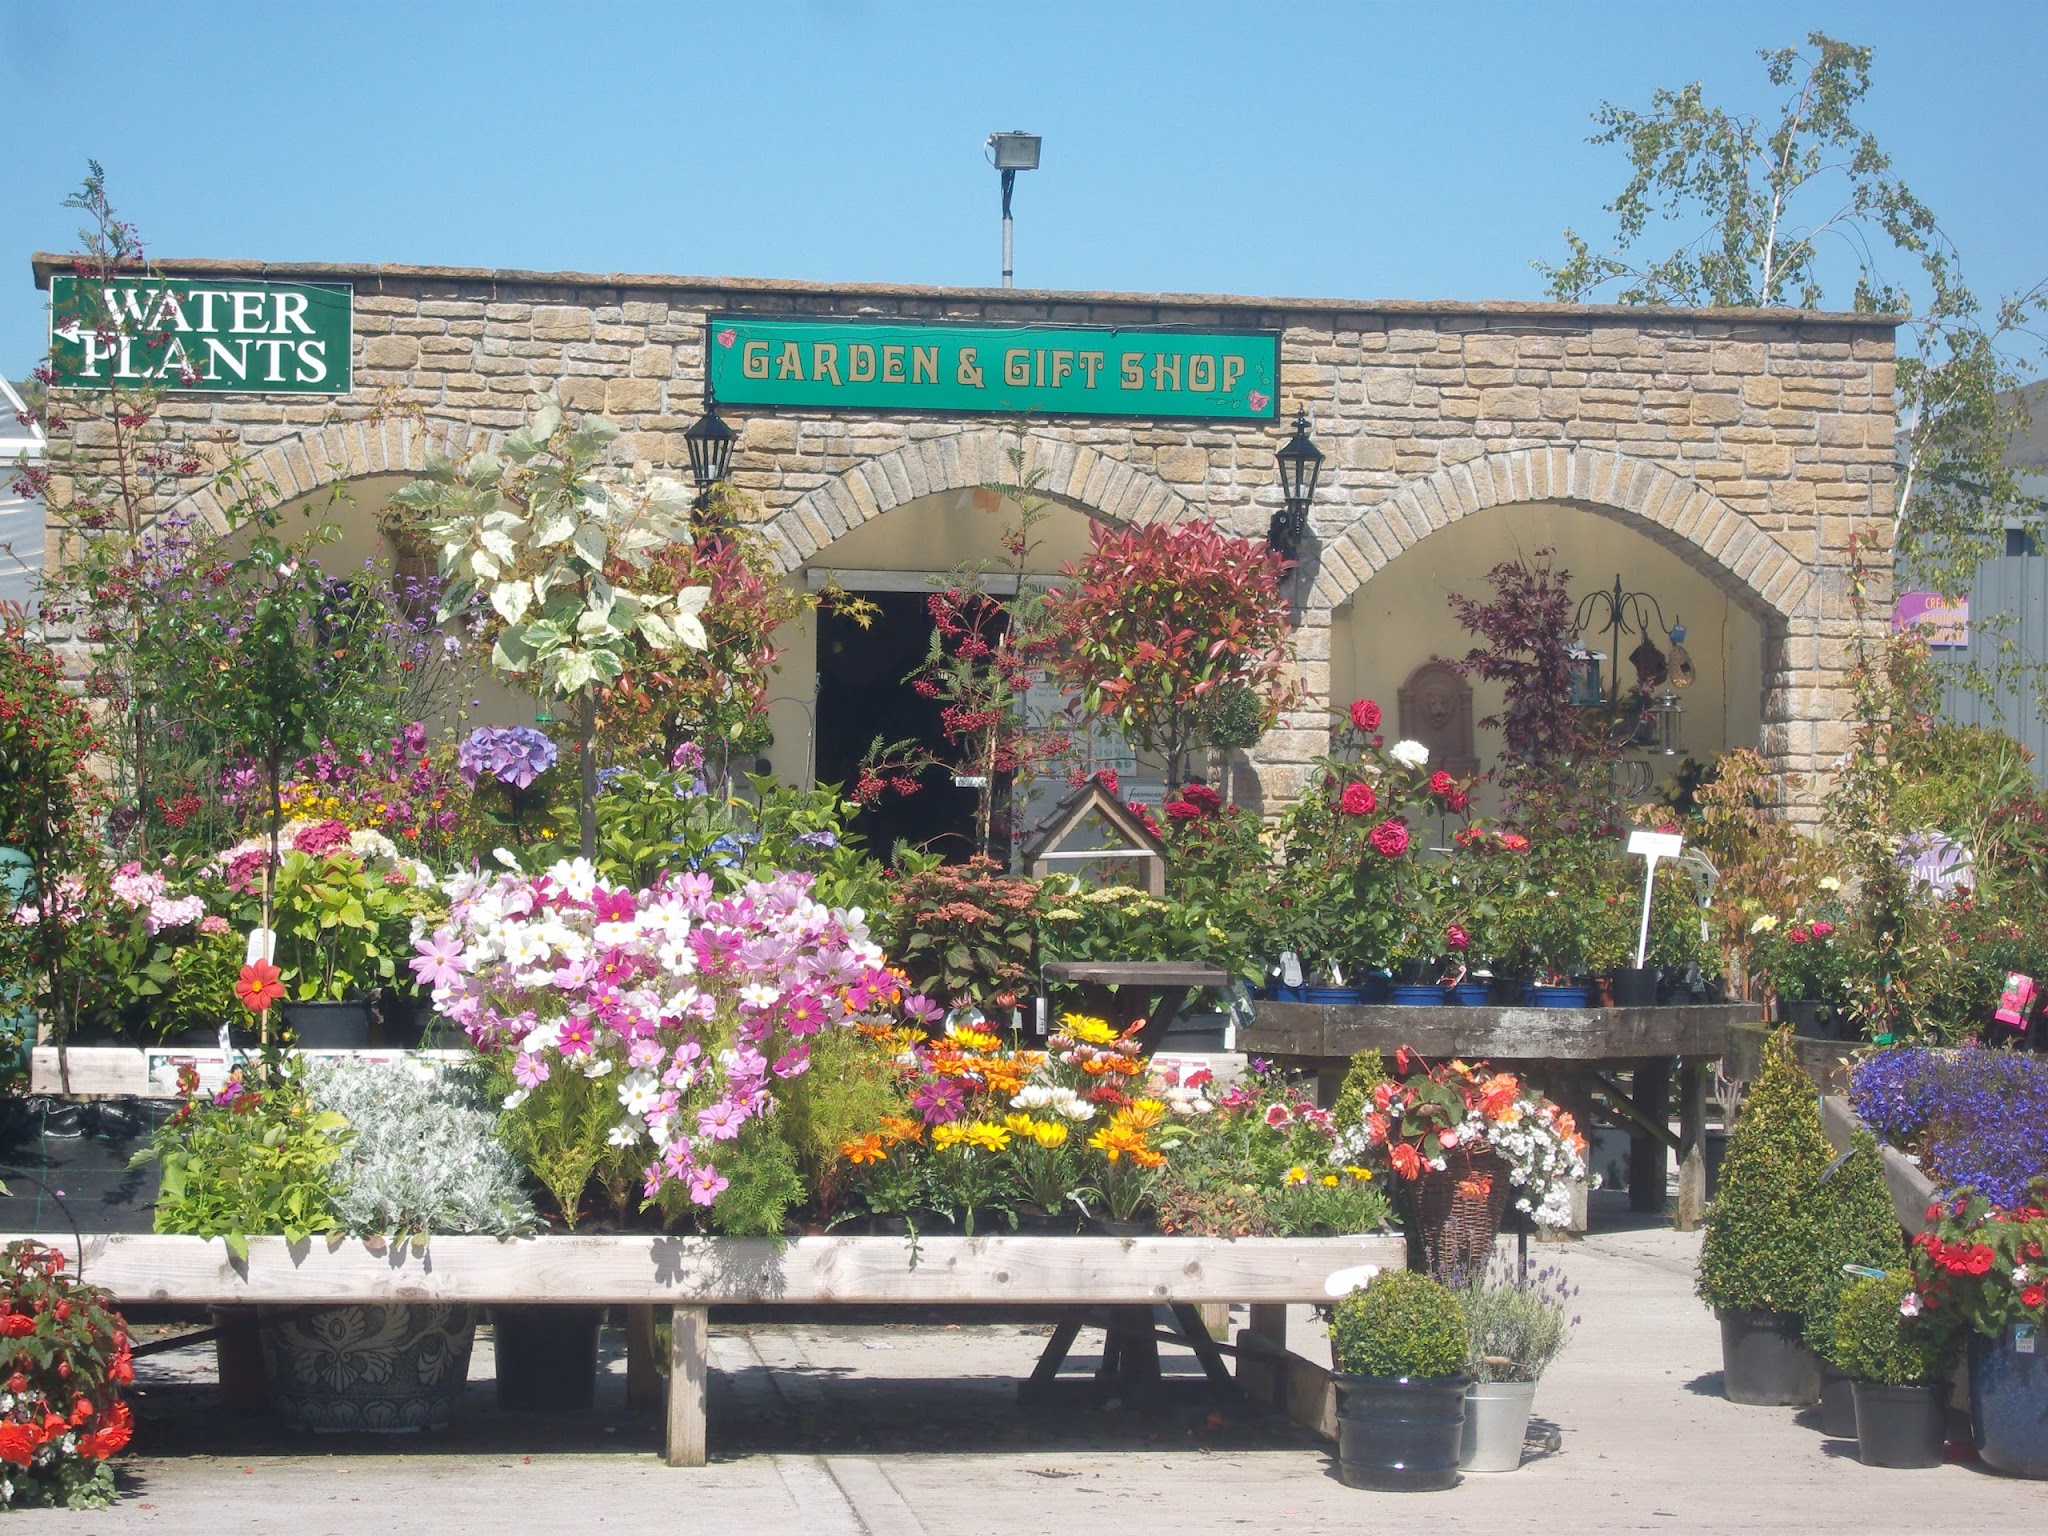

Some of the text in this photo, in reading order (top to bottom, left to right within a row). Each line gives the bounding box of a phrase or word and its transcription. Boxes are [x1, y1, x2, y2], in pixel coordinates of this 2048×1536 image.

[103, 288, 316, 335] WATER
[79, 335, 328, 384] PLANTS
[742, 340, 1246, 393] GARDEN & GIFT SHOP
